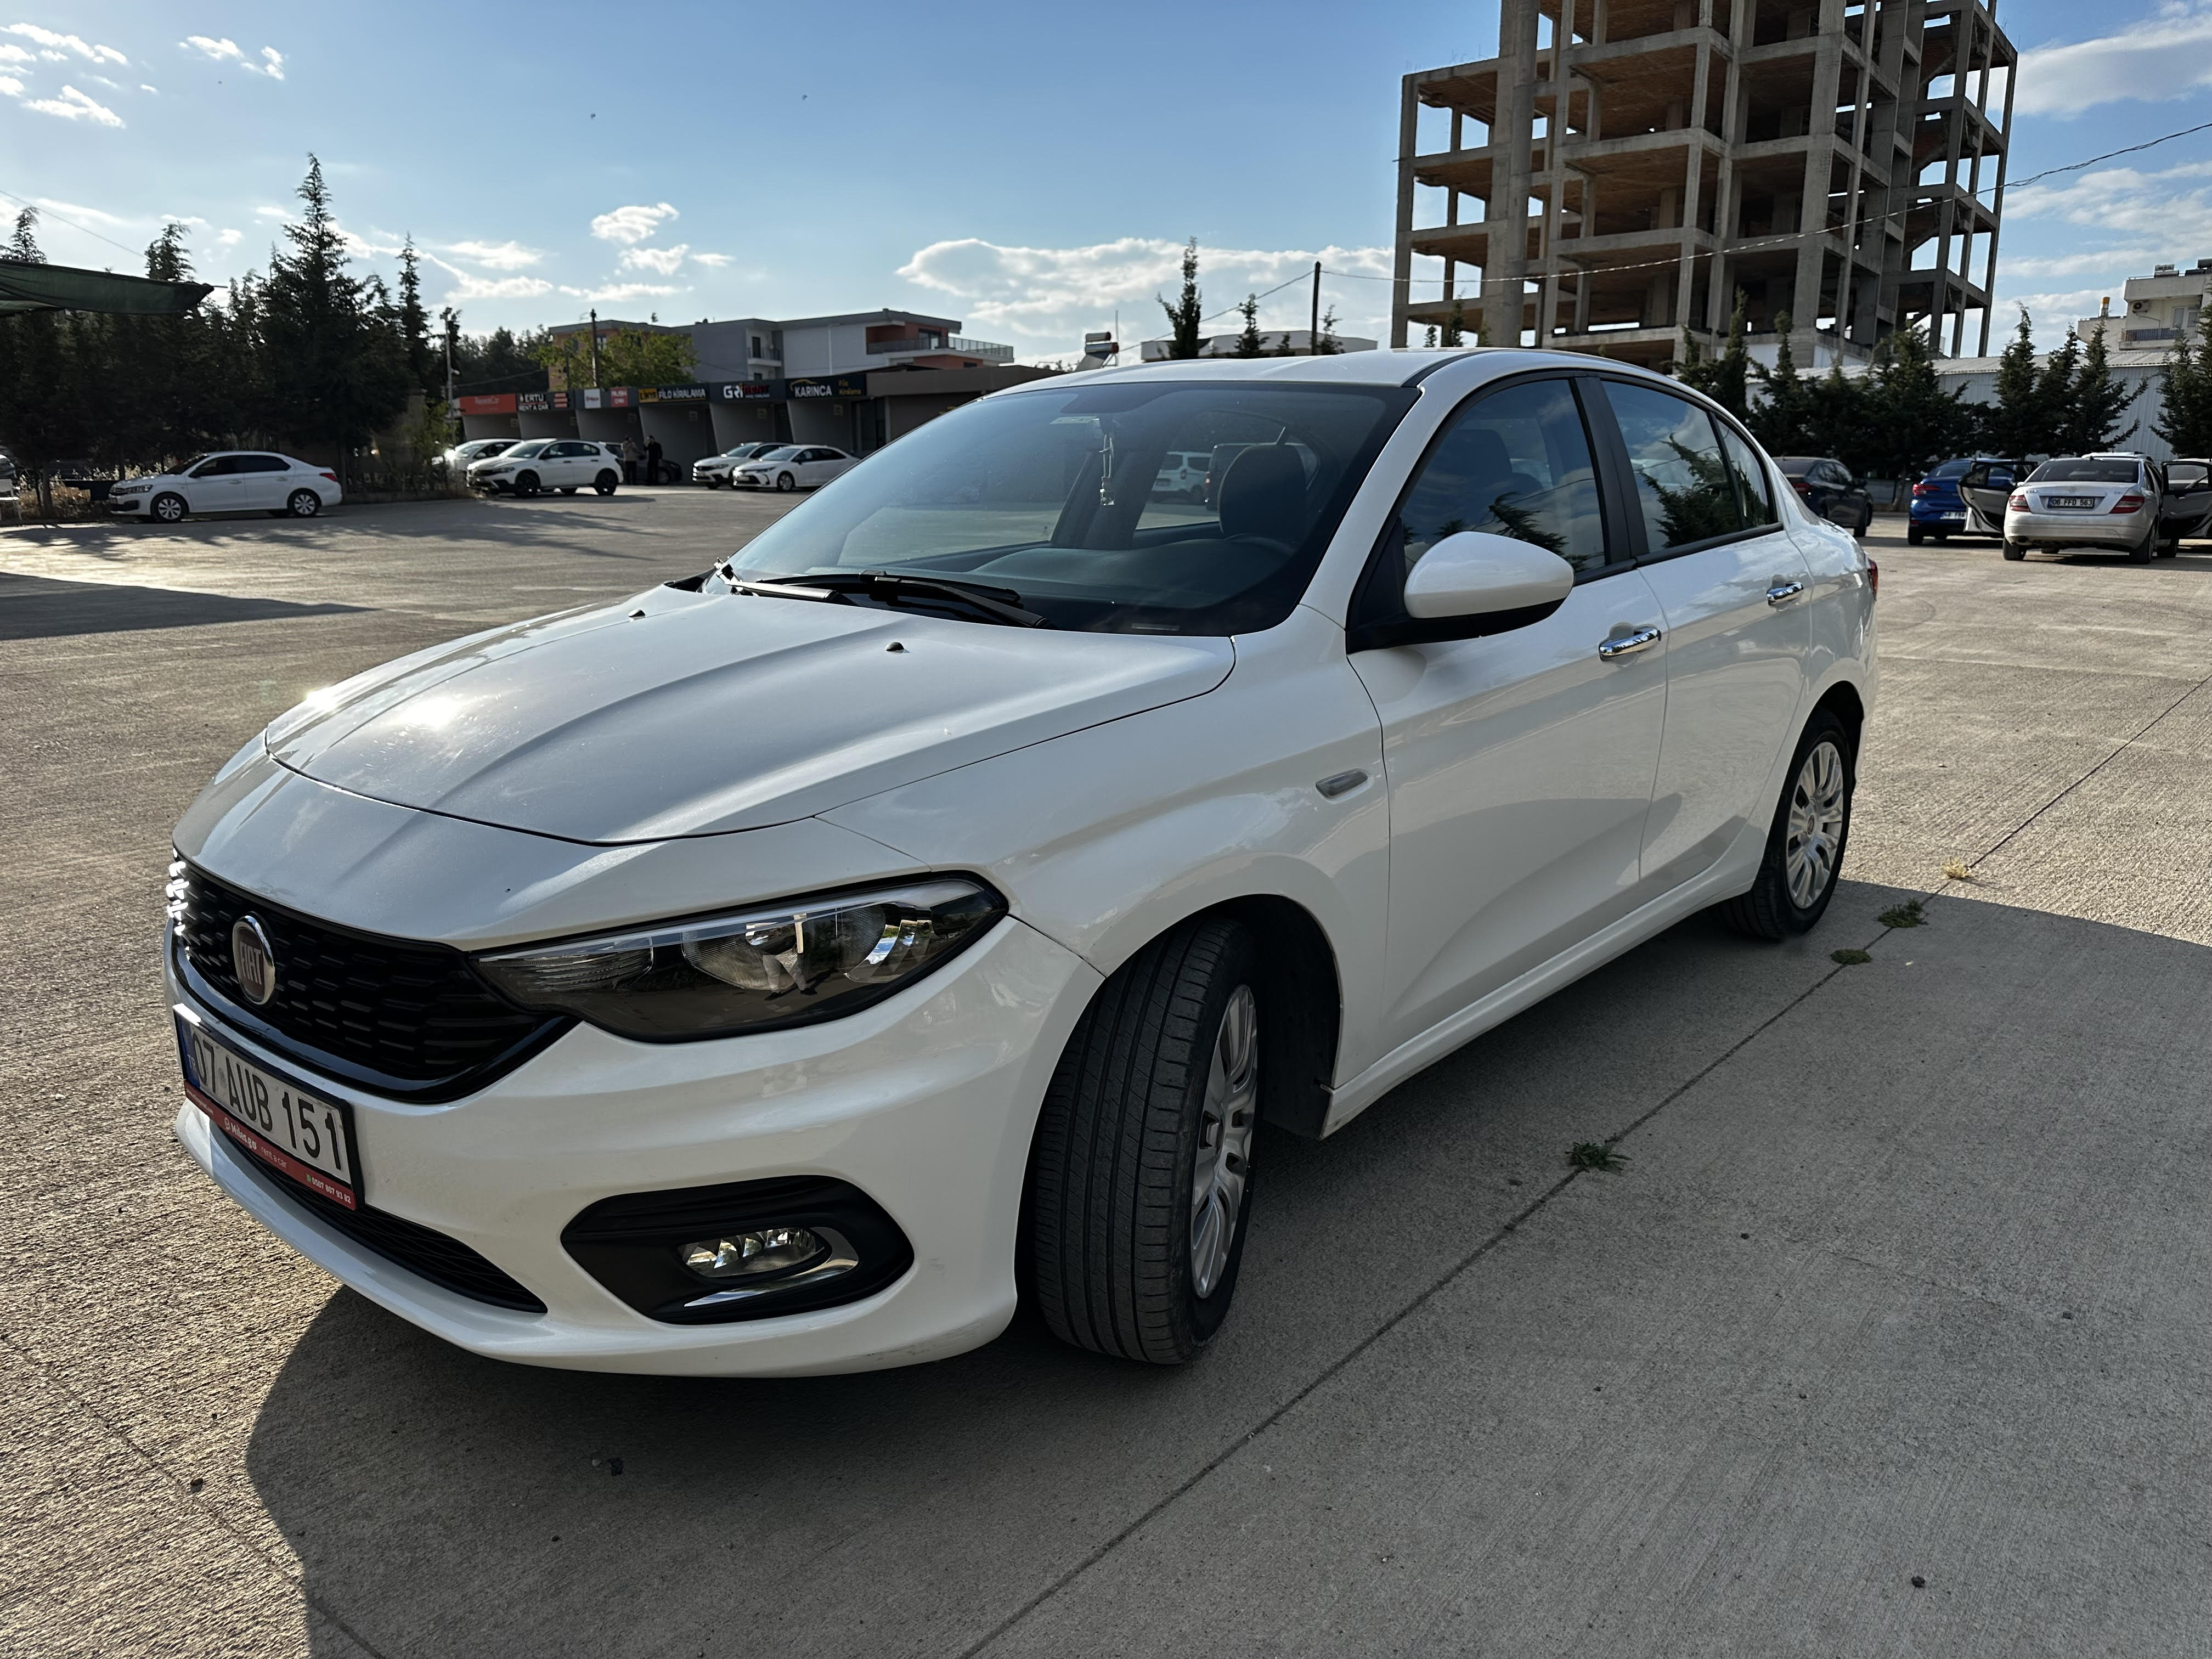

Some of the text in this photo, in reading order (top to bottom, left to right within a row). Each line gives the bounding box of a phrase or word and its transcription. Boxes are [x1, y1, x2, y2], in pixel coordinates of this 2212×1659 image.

[794, 385, 833, 397] KARINCA
[239, 940, 262, 985] FIAT
[192, 1032, 341, 1171] 07 AUB 151
[261, 1146, 273, 1160] rent
[278, 1158, 287, 1169] car
